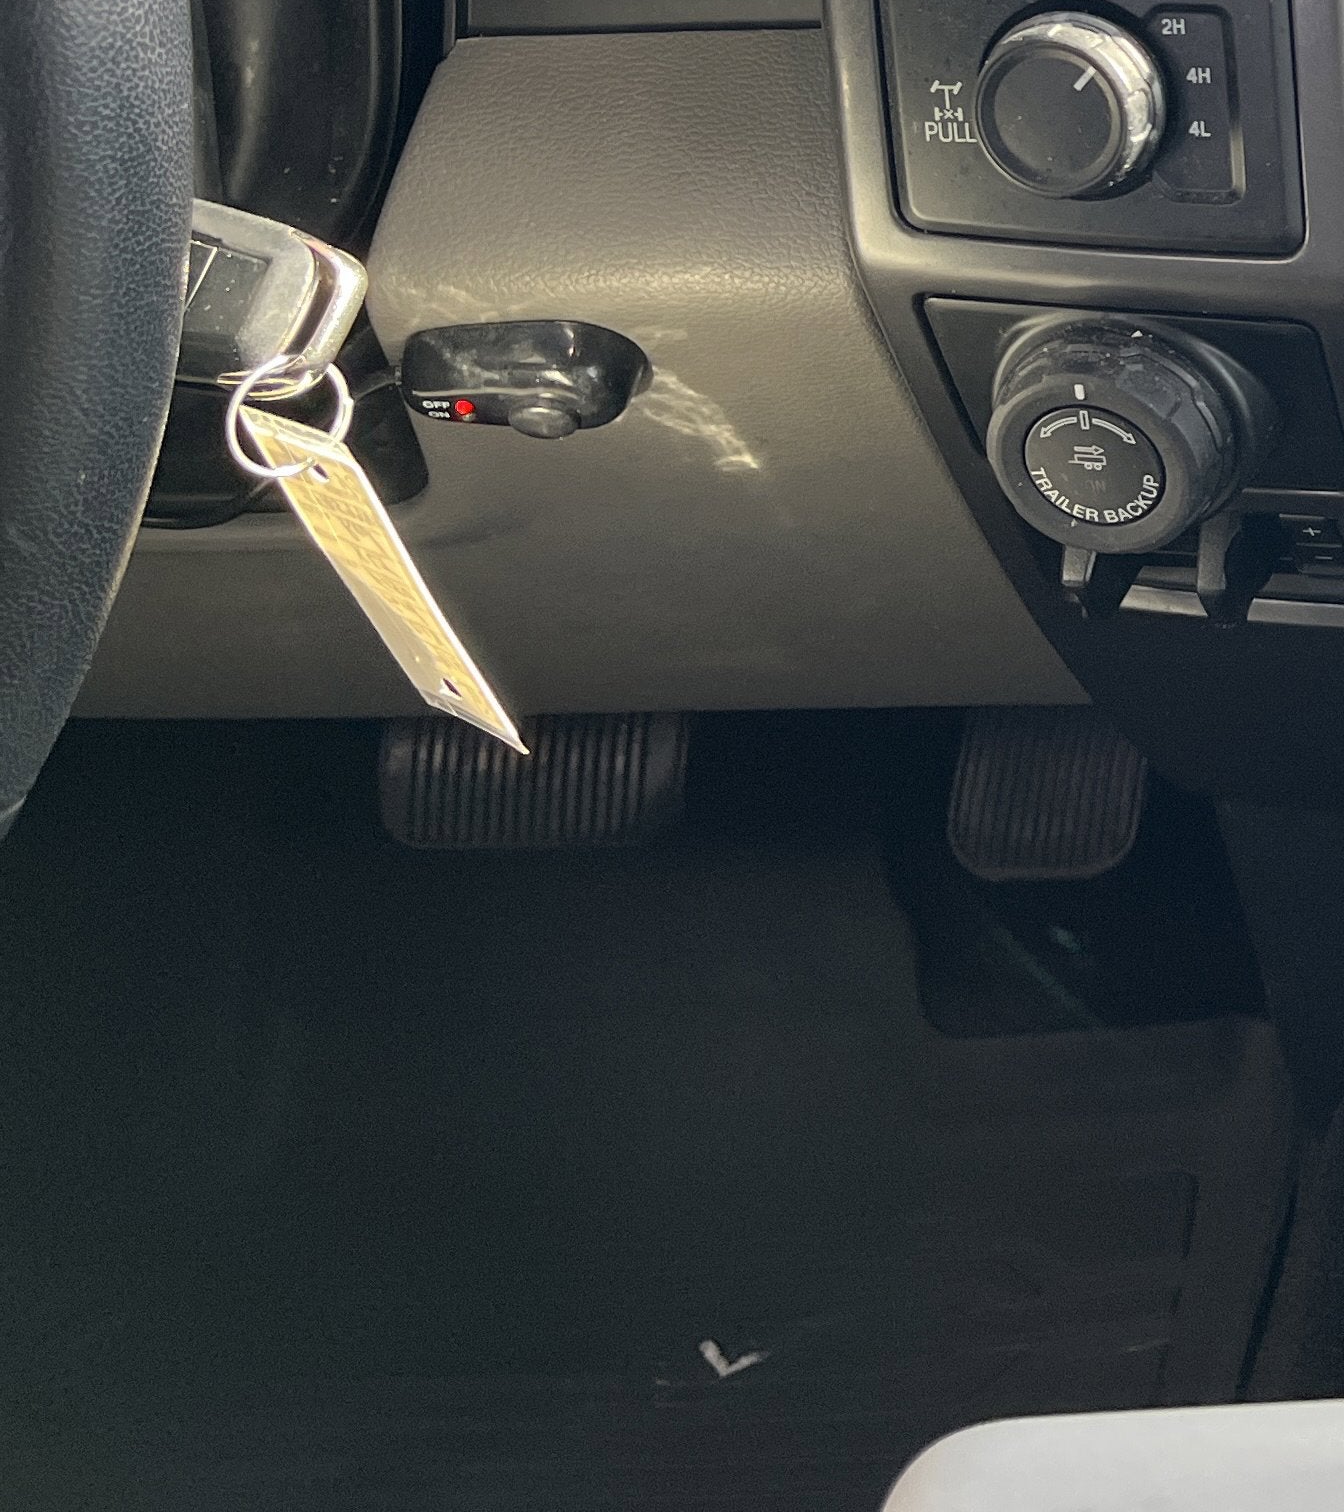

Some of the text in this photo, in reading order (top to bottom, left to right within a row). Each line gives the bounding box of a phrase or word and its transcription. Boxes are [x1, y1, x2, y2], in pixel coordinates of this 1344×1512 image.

[1161, 18, 1186, 35] 2H
[1186, 67, 1212, 84] 4H
[924, 121, 978, 143] PULL
[1188, 120, 1212, 138] 4L
[1031, 466, 1160, 524] TRAILER BACKUP
